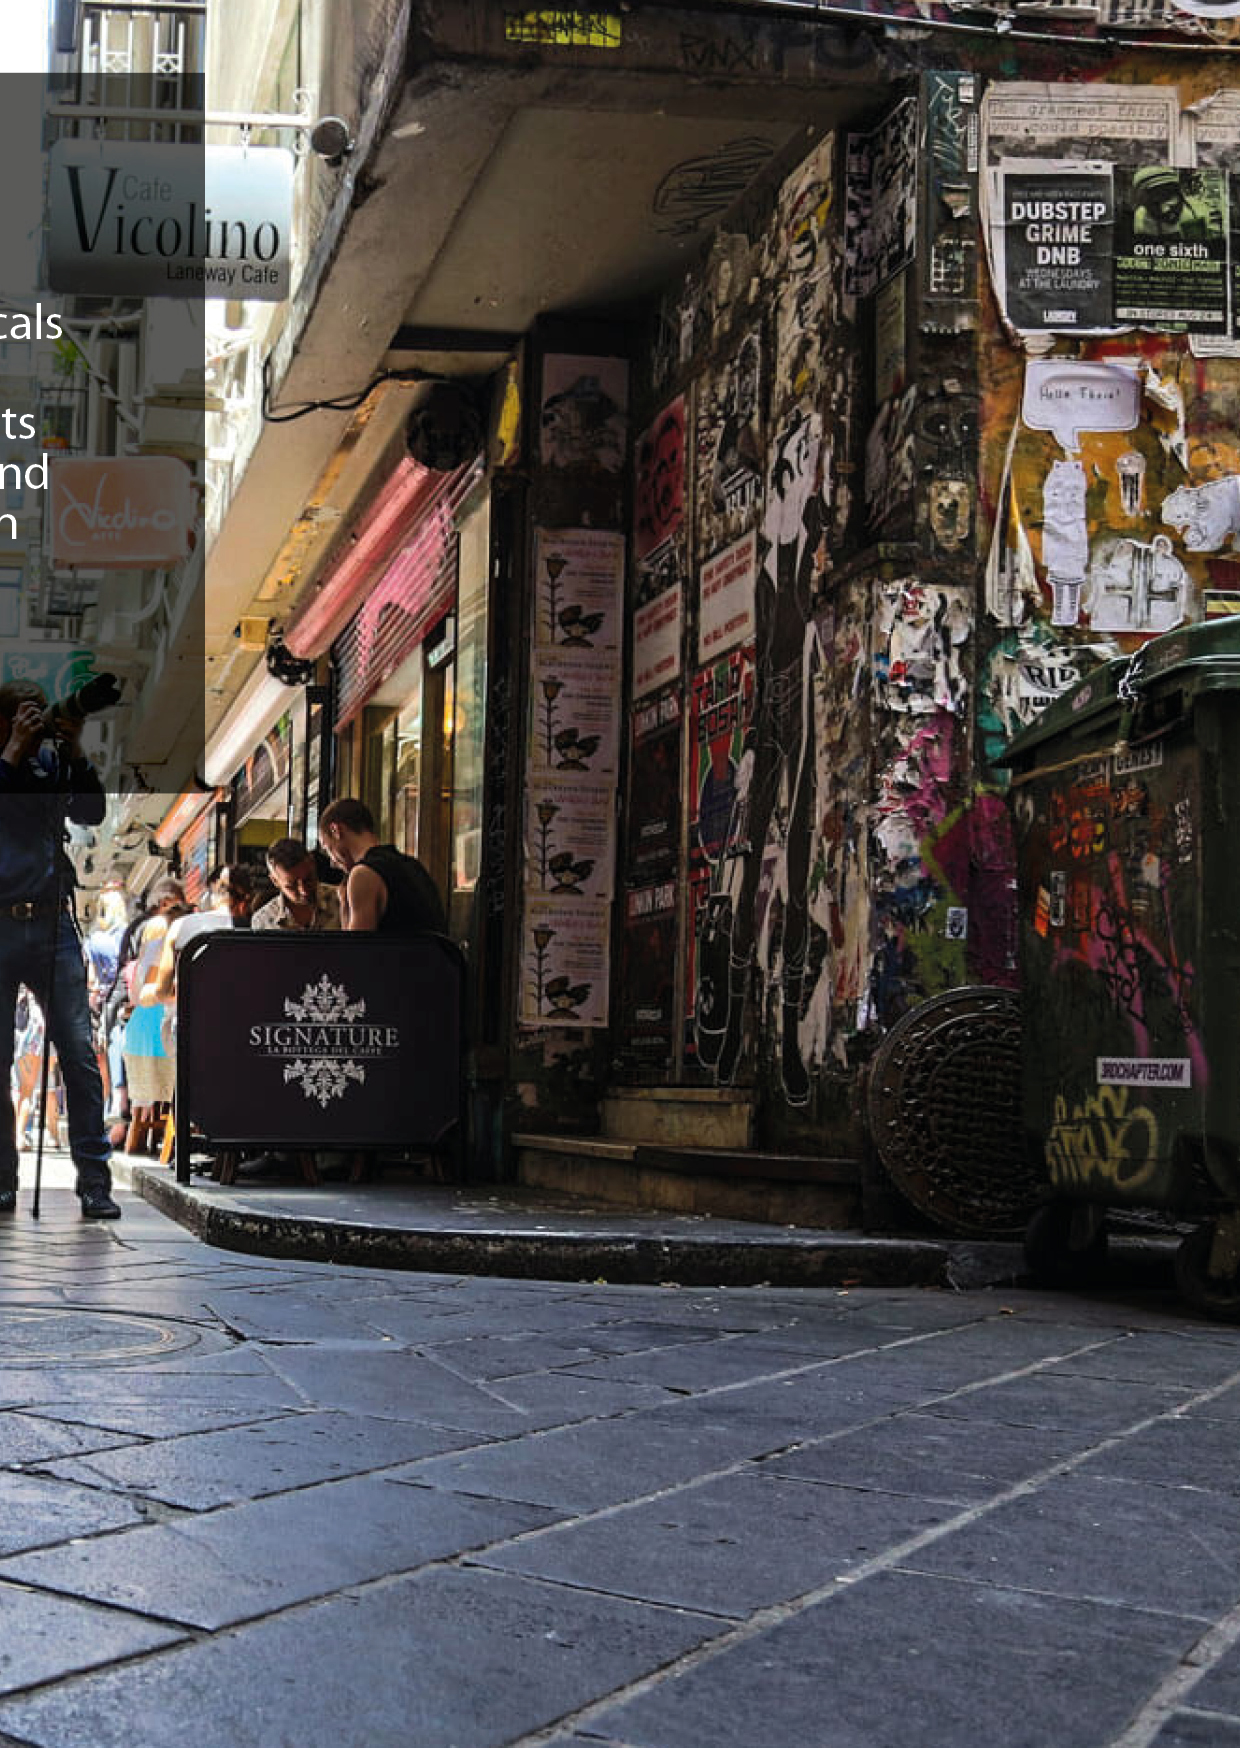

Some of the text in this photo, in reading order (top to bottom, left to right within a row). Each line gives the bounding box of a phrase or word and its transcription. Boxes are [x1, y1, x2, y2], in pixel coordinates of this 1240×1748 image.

[121, 173, 173, 202] Cafe
[62, 164, 281, 262] Vicolino
[1011, 201, 1107, 221] DUBSTEP
[1025, 223, 1093, 243] GRIME
[1036, 246, 1081, 265] DNB
[1133, 242, 1208, 259] one sixth
[166, 262, 280, 286] Laneway Cafe
[248, 1025, 400, 1047] SIGNATURE
